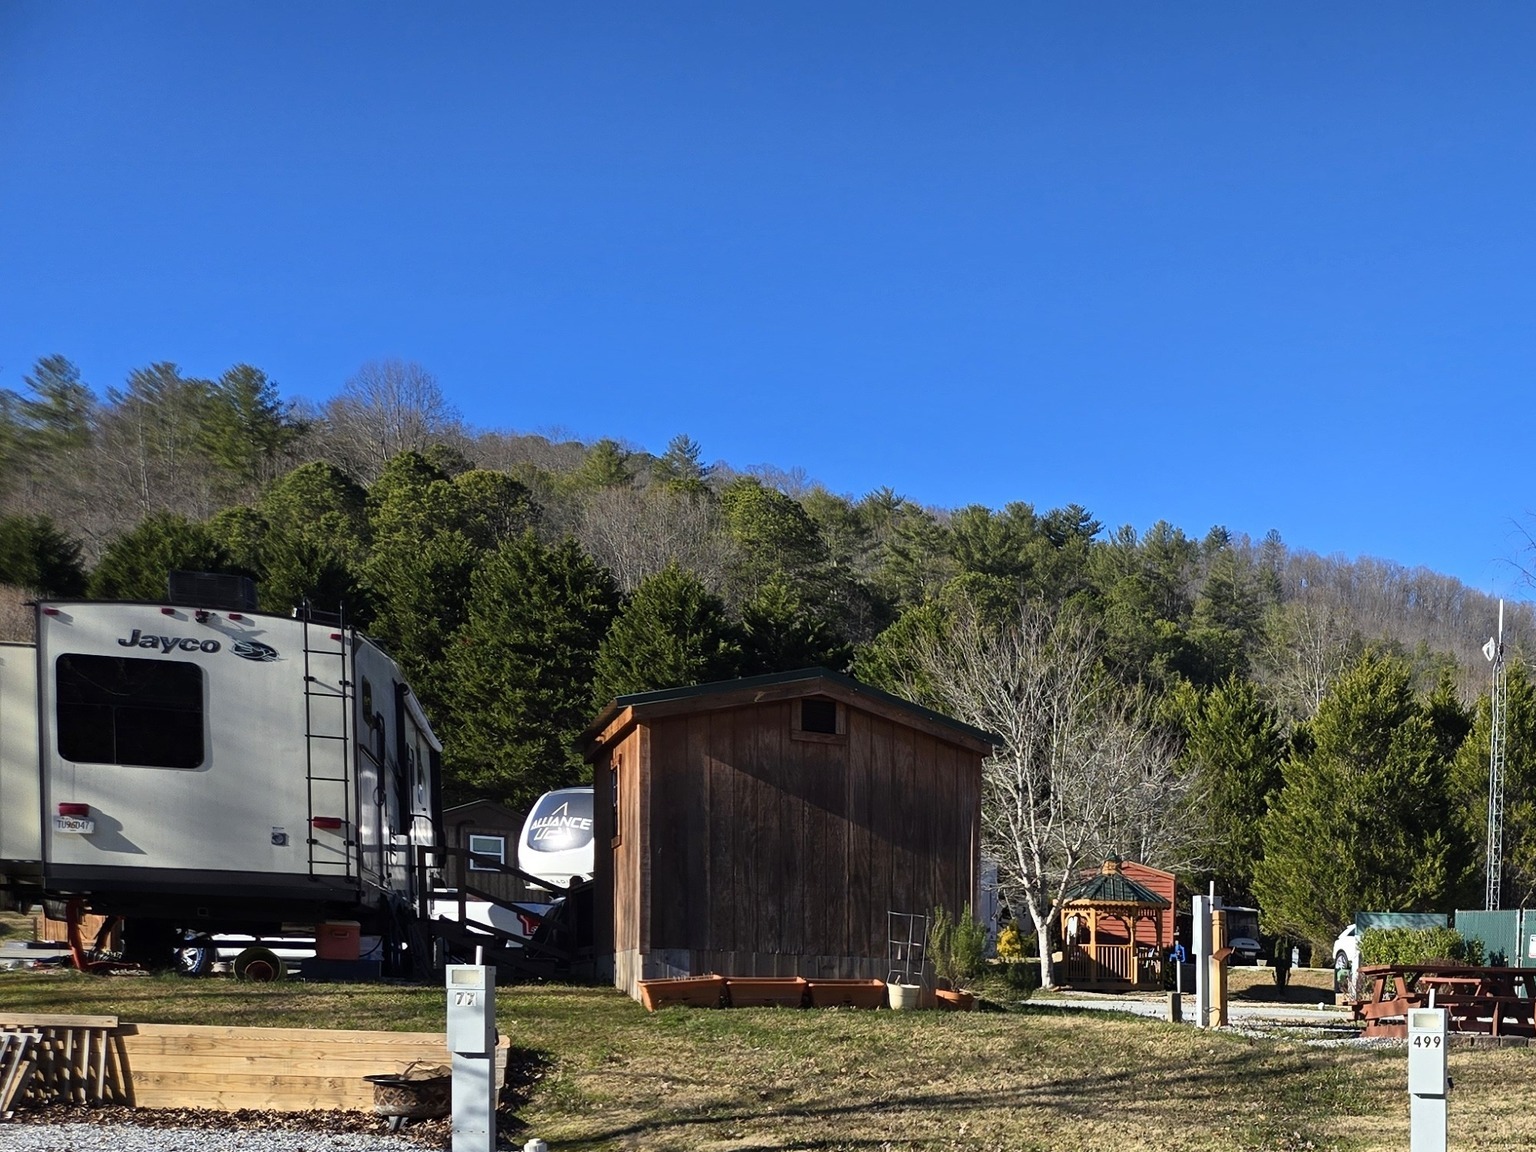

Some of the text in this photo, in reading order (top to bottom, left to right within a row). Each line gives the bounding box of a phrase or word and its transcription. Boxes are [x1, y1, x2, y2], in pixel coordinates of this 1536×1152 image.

[118, 629, 221, 654] Jayco
[530, 816, 593, 830] ALLIANCE
[456, 992, 475, 1005] 77
[1413, 1036, 1441, 1048] 499
